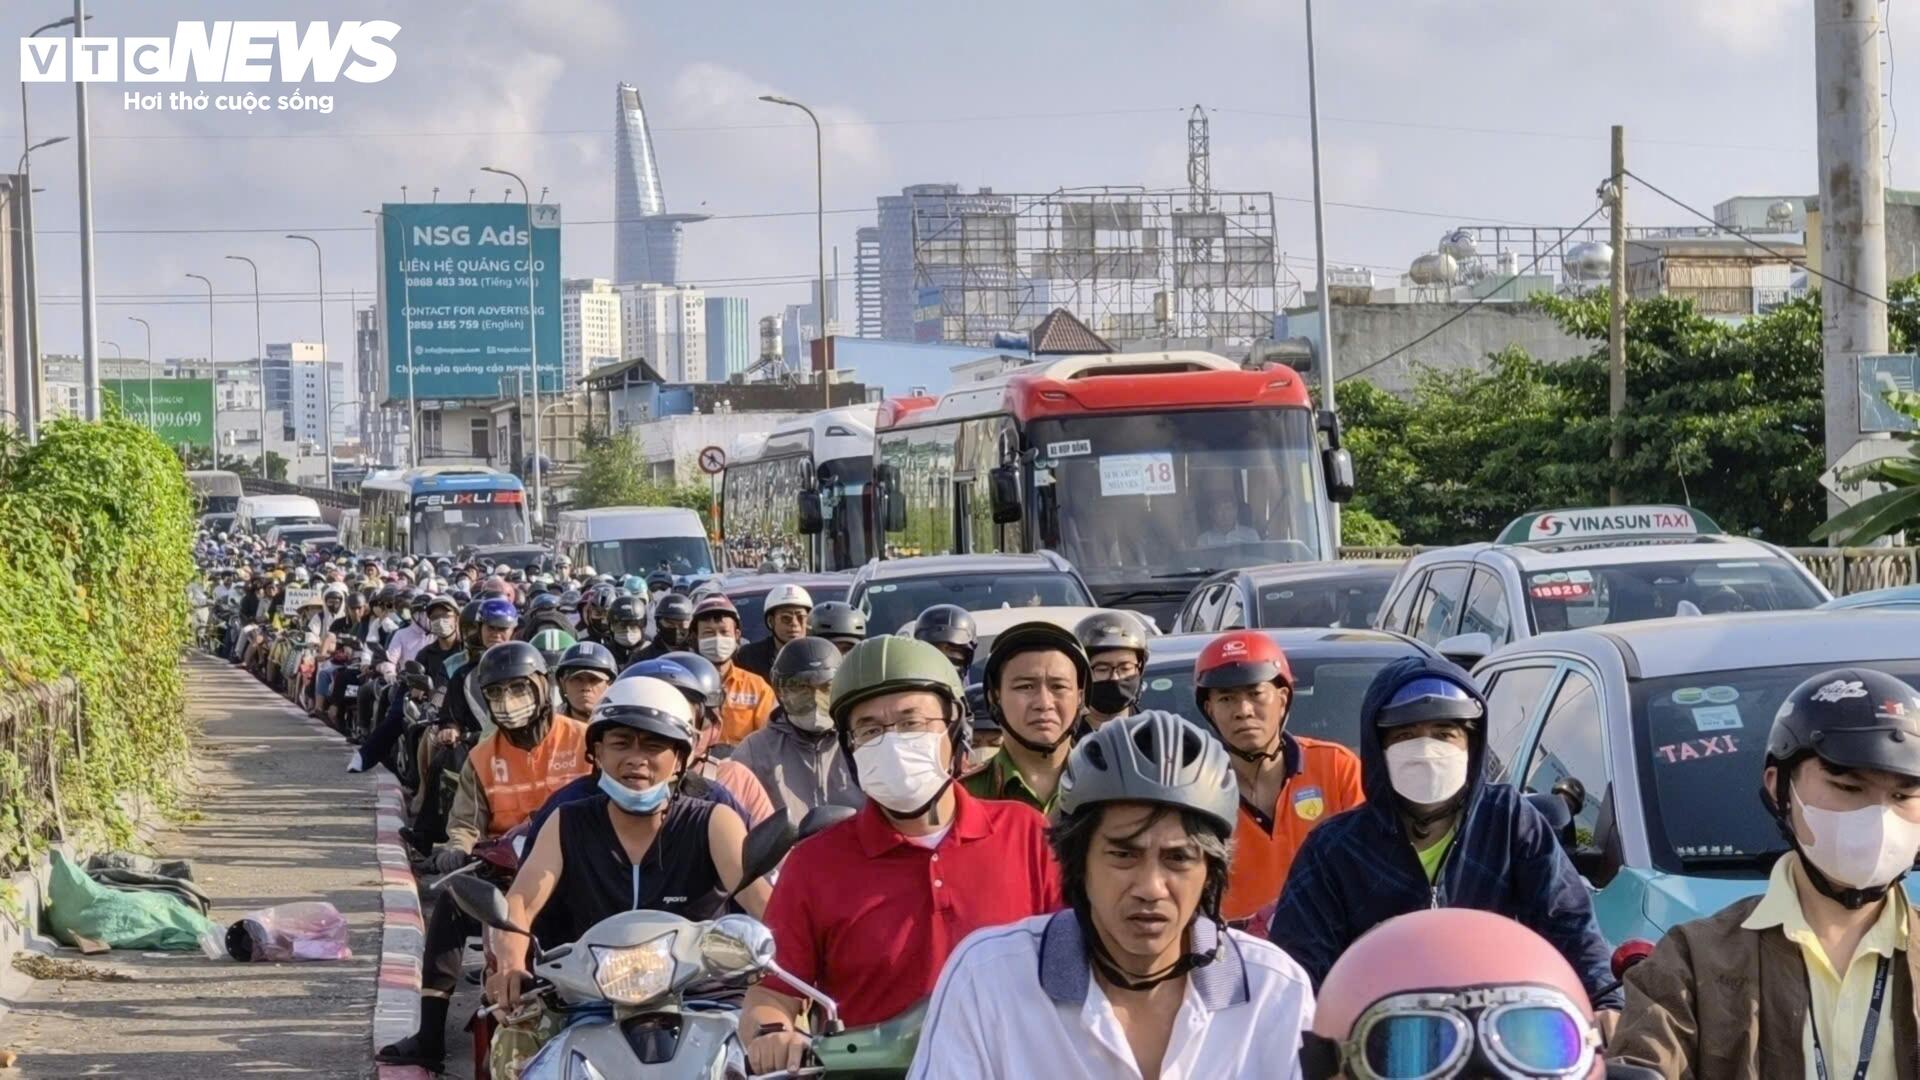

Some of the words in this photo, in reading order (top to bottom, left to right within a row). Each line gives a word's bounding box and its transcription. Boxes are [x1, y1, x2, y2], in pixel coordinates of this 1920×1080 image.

[413, 225, 470, 246] NSG
[477, 225, 529, 246] Ads
[399, 257, 430, 272] LIÊN
[434, 257, 454, 275] HỆ
[457, 257, 510, 273] QUẢNG
[458, 277, 479, 287] 301
[401, 306, 451, 317] CONTACT
[453, 306, 475, 316] FOR
[478, 306, 545, 316] ADVERTISG
[482, 319, 524, 331] (English)
[395, 363, 432, 375] Chyên
[434, 364, 451, 375] gia
[1144, 462, 1172, 483] 18
[1569, 515, 1651, 531] VINASUN
[1653, 513, 1688, 527] TAXI
[1659, 735, 1738, 762] TAXI
